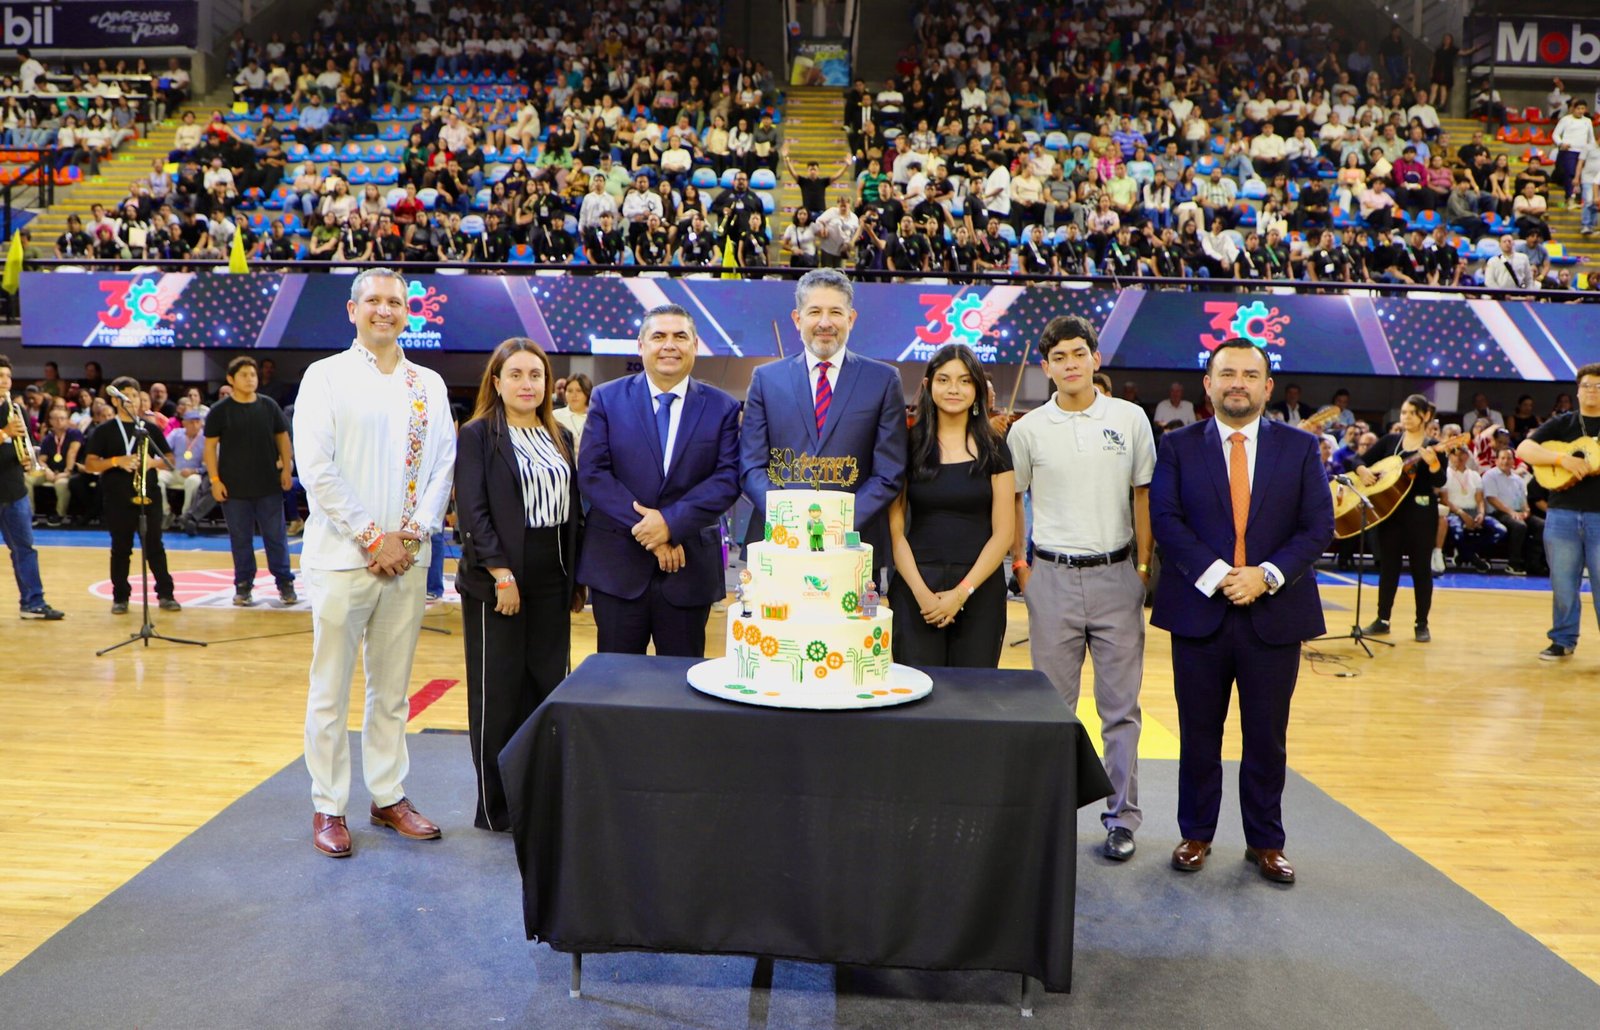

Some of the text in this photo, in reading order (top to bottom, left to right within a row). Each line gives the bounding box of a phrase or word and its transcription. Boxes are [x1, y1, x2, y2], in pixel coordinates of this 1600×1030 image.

[2, 6, 54, 45] bil
[626, 361, 645, 372] ZO
[769, 447, 796, 467] 30
